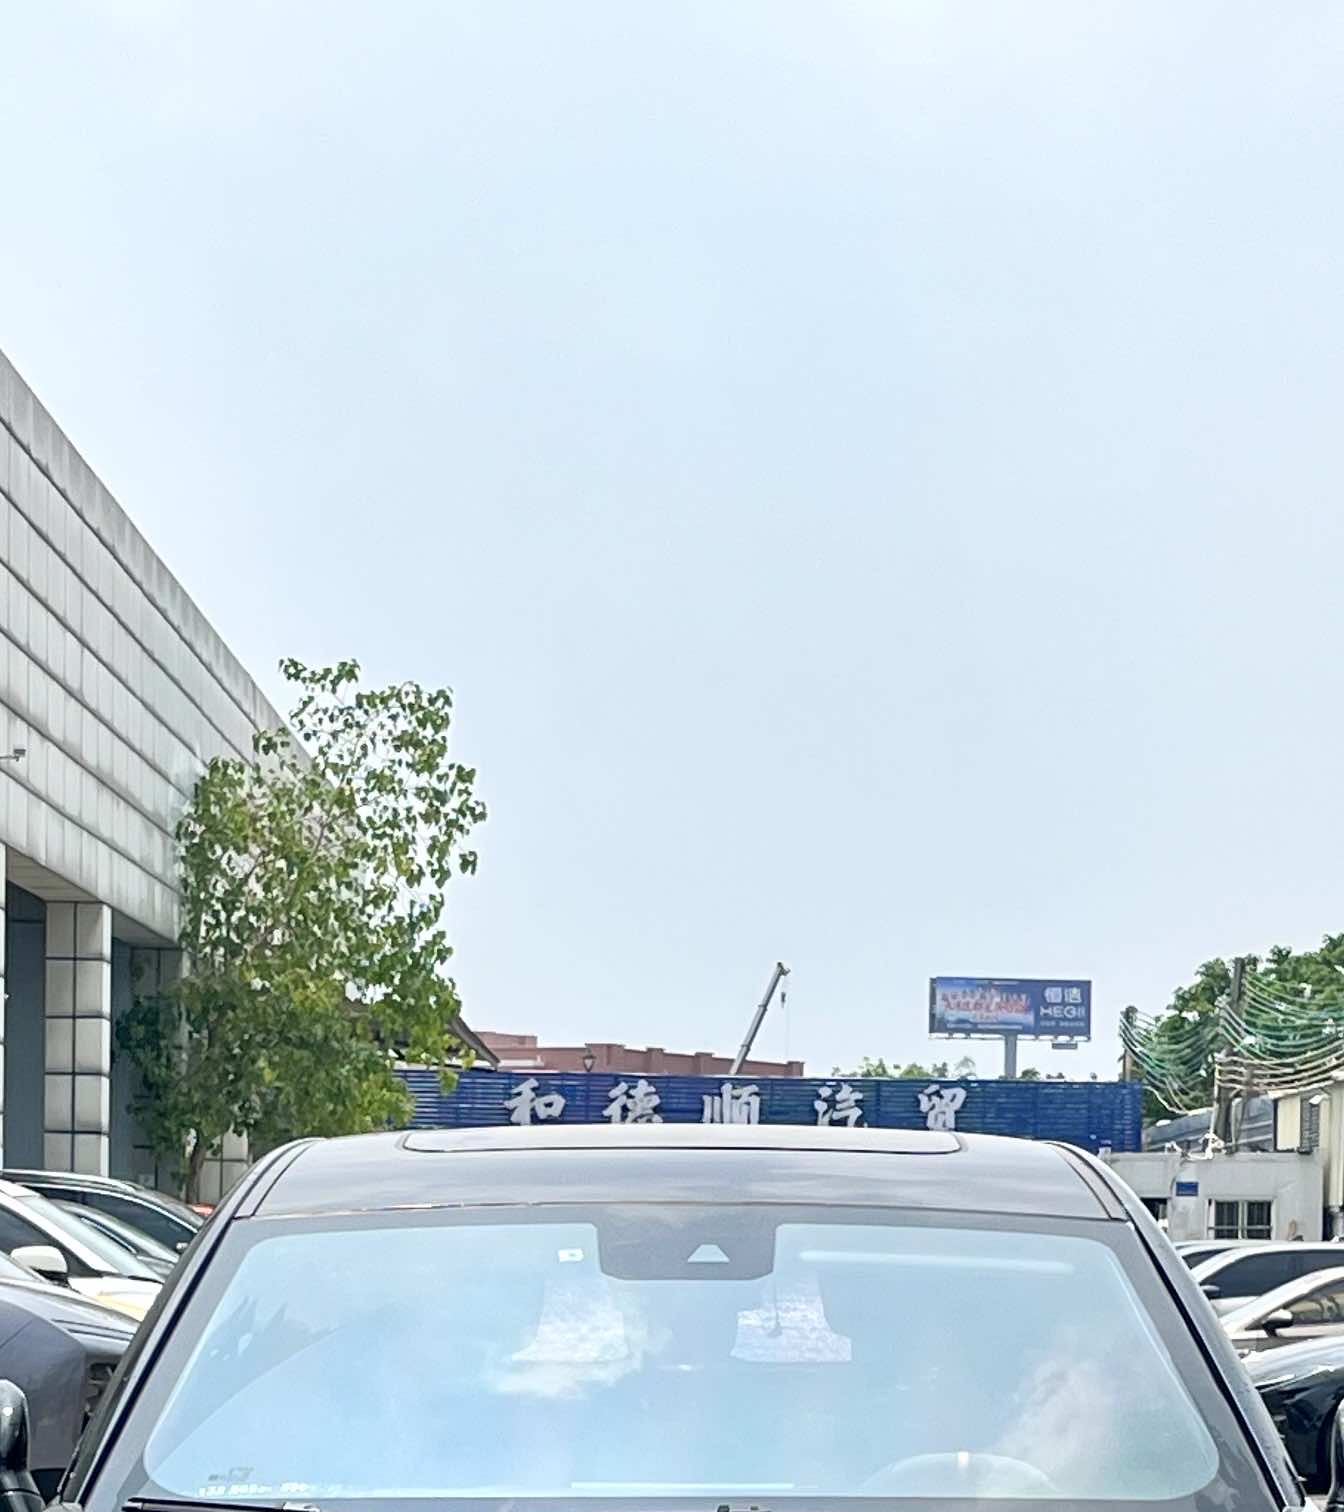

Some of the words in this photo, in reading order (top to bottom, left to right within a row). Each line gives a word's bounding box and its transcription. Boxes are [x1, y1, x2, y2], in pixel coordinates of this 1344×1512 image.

[503, 1077, 966, 1131] 和德顺汽贸
